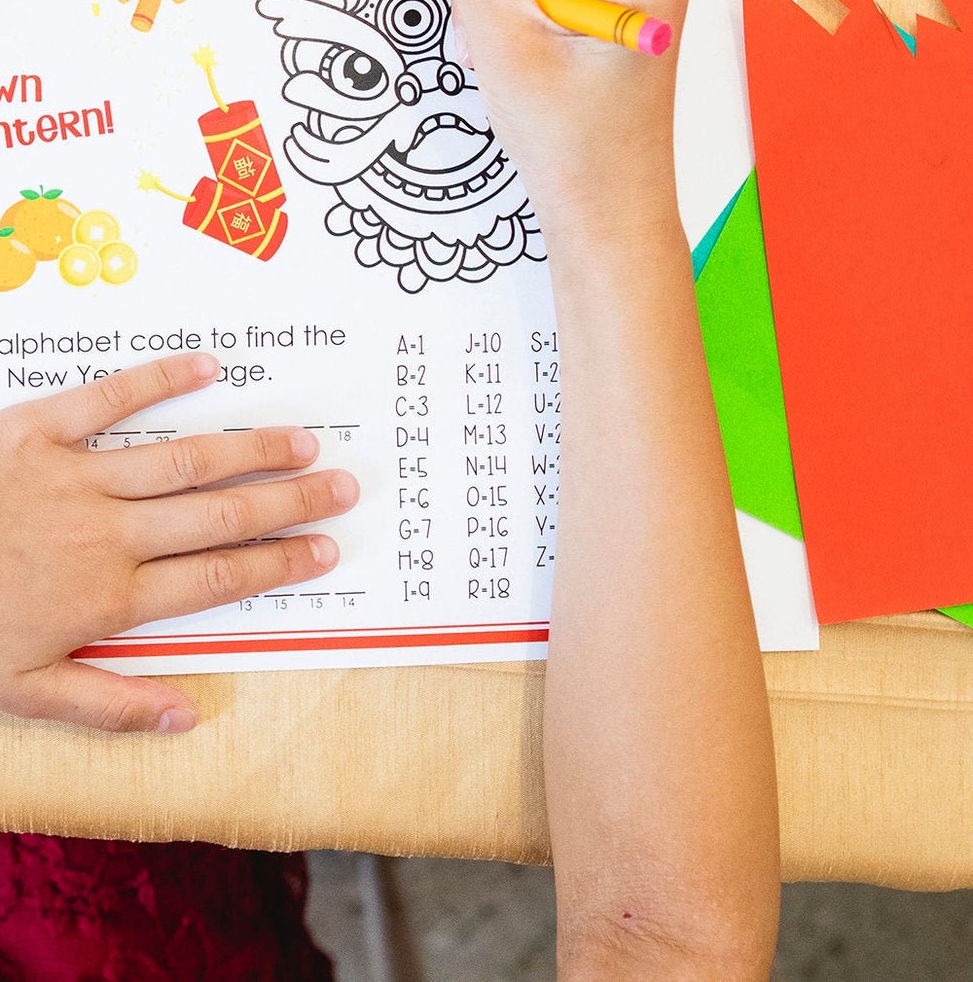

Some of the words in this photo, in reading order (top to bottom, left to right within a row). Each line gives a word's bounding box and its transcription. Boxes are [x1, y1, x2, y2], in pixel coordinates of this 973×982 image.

[130, 328, 201, 351] code
[211, 328, 236, 348] to
[246, 325, 293, 347] find
[304, 325, 346, 346] the
[397, 335, 424, 355] A=1
[465, 332, 501, 353] J=10
[531, 332, 557, 352] S=1
[8, 367, 68, 388] New
[397, 365, 426, 386] B=2
[466, 363, 501, 384] K=11
[395, 395, 428, 417] C=3
[467, 393, 502, 414] L=12
[123, 438, 131, 448] 5
[339, 431, 351, 442] 18
[396, 427, 429, 447] D=4
[464, 424, 506, 445] M=13
[399, 457, 427, 478] E=5
[466, 455, 506, 476] N=14
[399, 488, 429, 509] F=6
[467, 485, 507, 507] O=15
[399, 519, 431, 539] G=7
[468, 516, 508, 537] P=16
[398, 550, 435, 570] H=8
[469, 547, 508, 568] Q=17
[403, 581, 430, 601] I=9
[468, 578, 510, 599] R=18
[275, 599, 288, 610] 15
[310, 598, 323, 609] 15
[342, 597, 355, 608] 14
